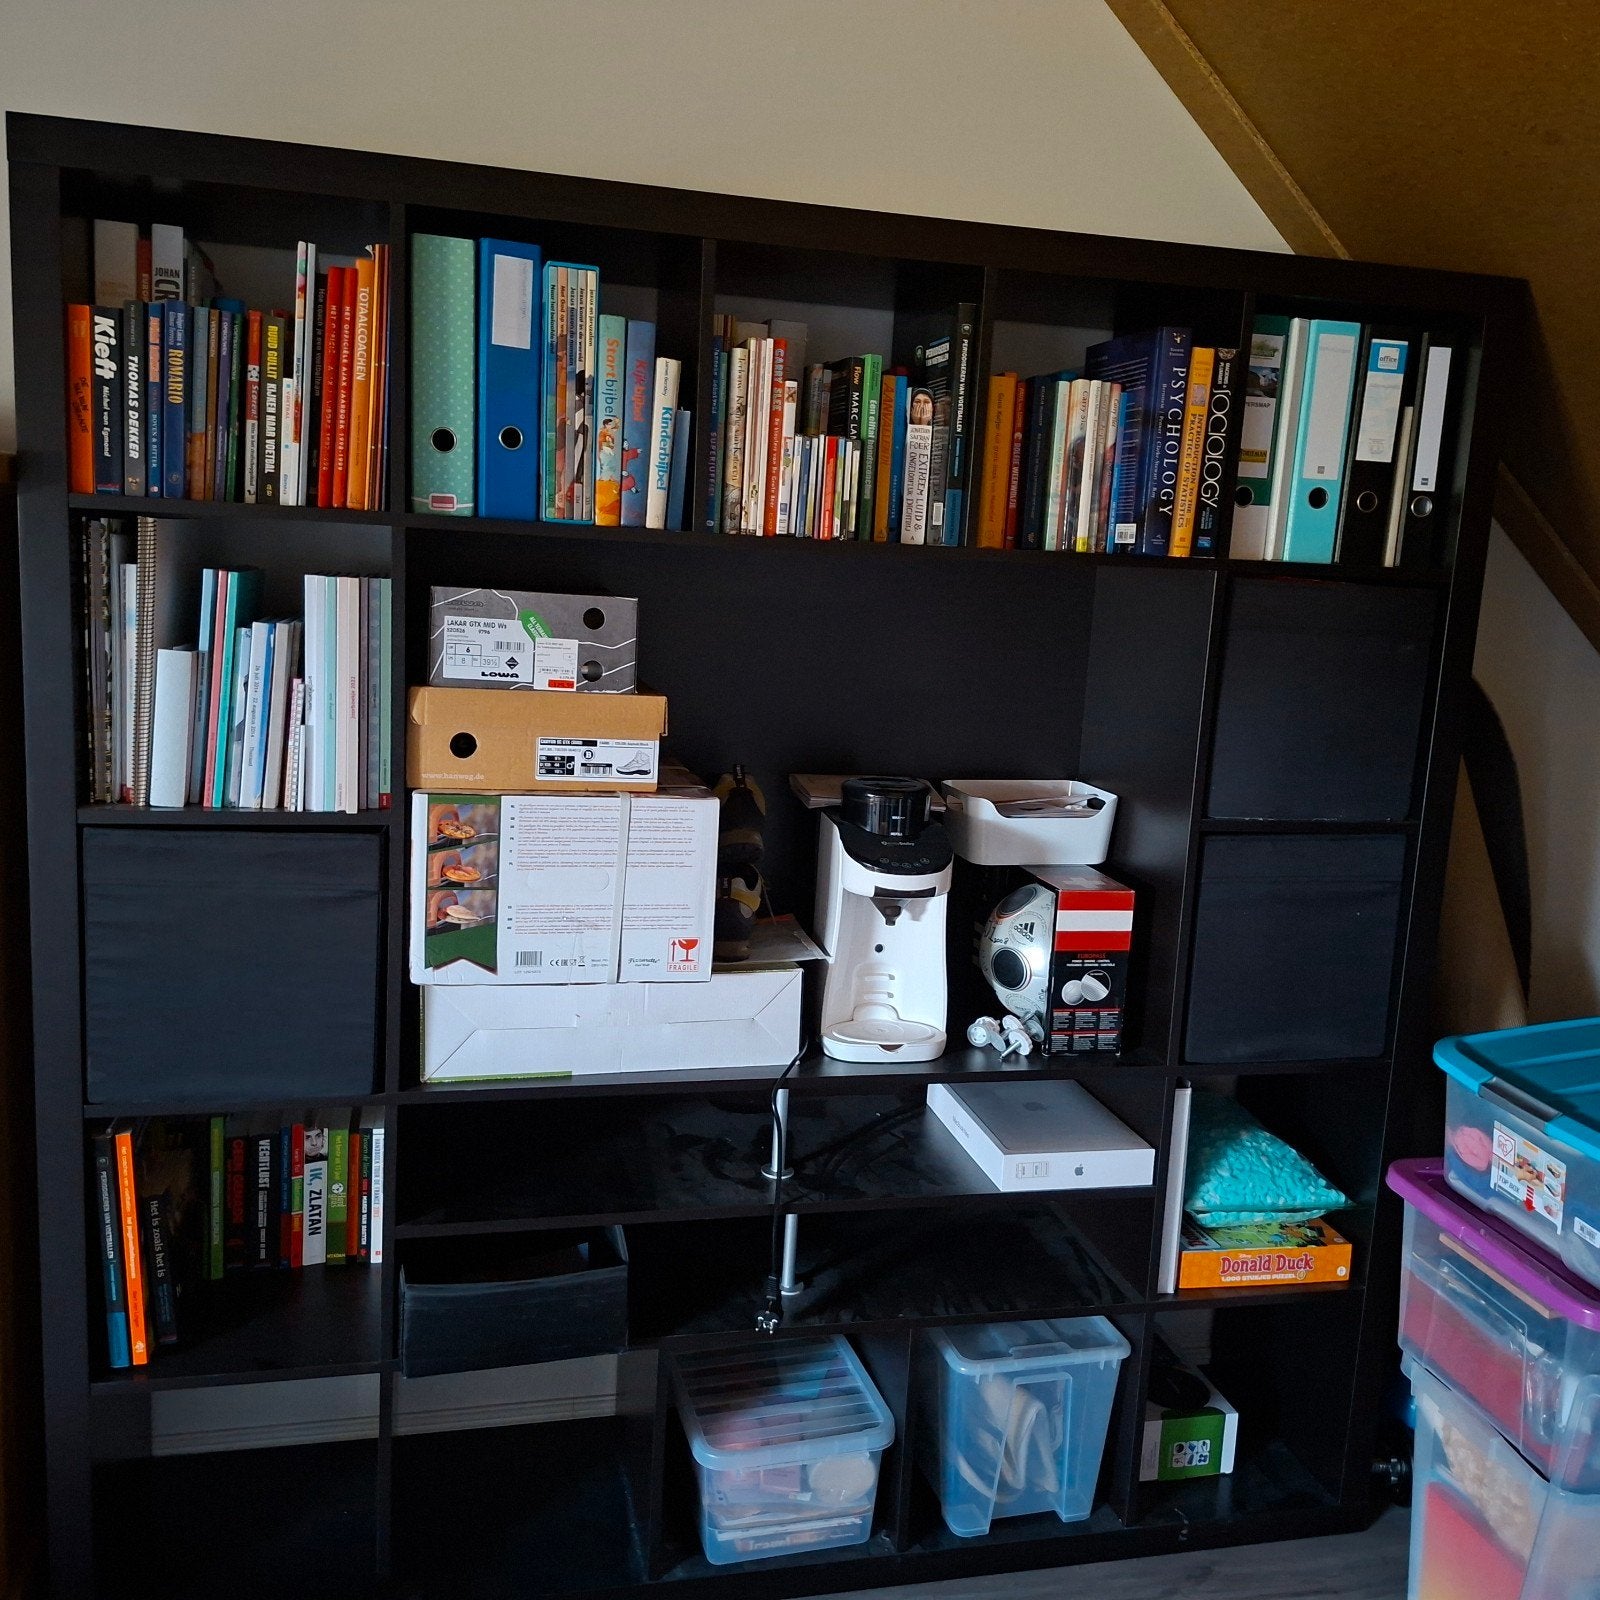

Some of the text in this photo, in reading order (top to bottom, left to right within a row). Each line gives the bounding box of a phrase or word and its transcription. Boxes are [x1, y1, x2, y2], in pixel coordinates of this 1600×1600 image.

[154, 267, 180, 278] JOHAN
[318, 288, 326, 302] Hoe
[316, 302, 325, 326] coach
[559, 314, 565, 323] op
[589, 308, 594, 316] en
[94, 315, 117, 380] Kieft
[315, 328, 324, 336] je
[356, 286, 369, 381] TOTAALCOACHEN
[569, 328, 575, 338] de
[578, 332, 584, 340] de
[266, 325, 278, 379] RUUD GULLIT
[960, 338, 969, 382] PERIODISEREN
[168, 348, 184, 404] ROMARIO
[314, 352, 323, 396] voetbalteam
[340, 366, 348, 386] AJAX
[602, 338, 620, 418] Startbijbel
[736, 356, 746, 390] Terlouw
[772, 348, 784, 411] CARRY SLEE
[958, 383, 966, 396] VAN
[128, 355, 139, 459] THOMAS DEKKER
[250, 384, 259, 418] Scoren!
[339, 389, 347, 429] JAARBOEK
[850, 392, 860, 420] MARC
[868, 400, 878, 414] Een
[956, 396, 965, 432] VOETBALLEN
[1080, 390, 1088, 412] Carry
[102, 427, 111, 457] Egmond
[264, 382, 276, 474] KIJKEN NAAR VOETBAL
[868, 415, 877, 438] elftal
[1159, 366, 1187, 515] PSYCHOLOGY
[656, 406, 673, 490] Kinderbijbel
[909, 442, 930, 450] FOER
[1200, 388, 1232, 508] SOCIOLOGY
[732, 447, 740, 482] Katoren
[771, 466, 777, 474] De
[916, 454, 928, 496] EXTREEM
[1009, 442, 1020, 509] DOLFJE WEERWOLFJE
[1178, 413, 1198, 528] PRACTICE OF STATISTICS
[1186, 414, 1204, 514] INTRODUCTION TO THE
[904, 498, 914, 532] DICHTBIJ
[914, 498, 925, 521] LUID
[469, 620, 482, 628] GTX
[585, 750, 592, 758] B
[1014, 925, 1034, 942] adidas
[232, 1139, 244, 1172] GEEN
[258, 1140, 270, 1188] VECHTLUST
[363, 1154, 370, 1162] de
[307, 1168, 323, 1236] IK, ZLATAN
[338, 1192, 346, 1207] Hard
[1509, 1182, 1520, 1192] BOX
[104, 1212, 112, 1224] VAN
[104, 1224, 114, 1259] VOETBALLEN
[149, 1200, 166, 1278] Het is zoals het is
[1220, 1252, 1314, 1276] Donald Duck
